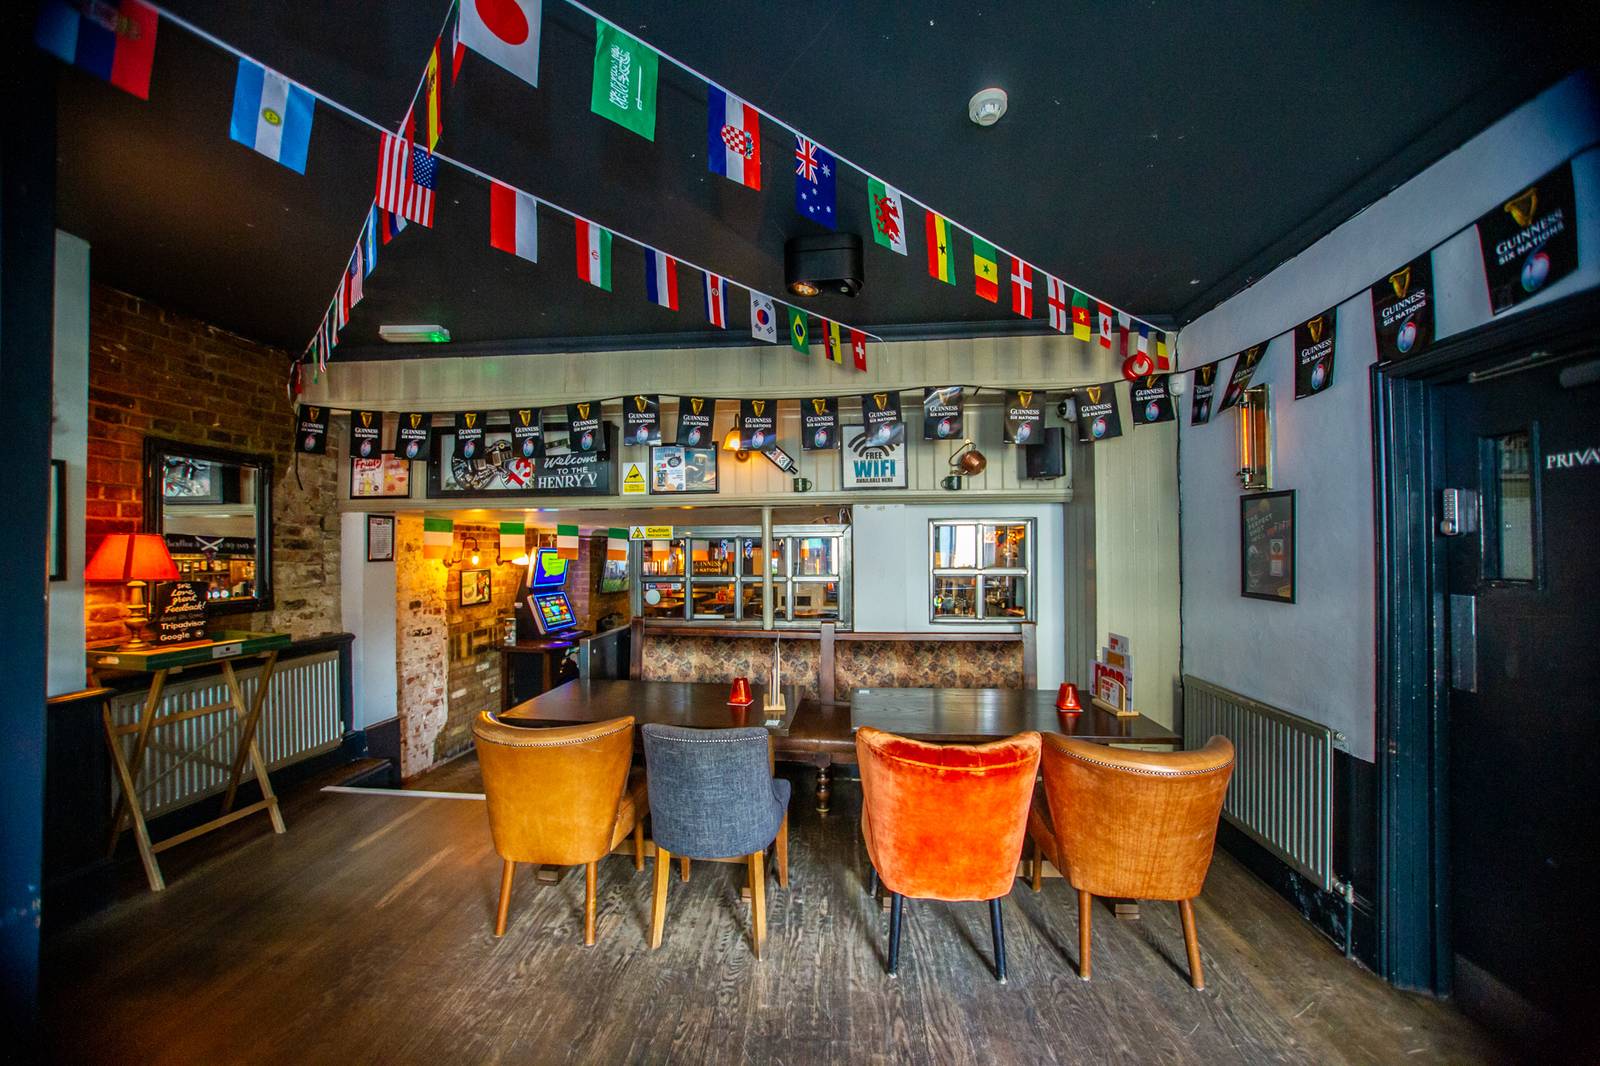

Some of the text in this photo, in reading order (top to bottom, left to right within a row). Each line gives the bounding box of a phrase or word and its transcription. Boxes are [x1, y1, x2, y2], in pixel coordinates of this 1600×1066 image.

[1496, 208, 1564, 256] GUINNESS
[1517, 222, 1564, 254] NATIONS
[1382, 289, 1426, 318] GUINNESS
[1395, 300, 1426, 321] NATIONS
[1302, 338, 1332, 358] GUINNESS
[1310, 348, 1332, 362] NATIONS
[1136, 388, 1164, 396] GUINNESS
[1081, 402, 1112, 412] GUINNESS
[1090, 409, 1112, 417] NATIONS
[683, 414, 710, 422] GUINNESS
[868, 410, 896, 418] GUINNESS
[572, 418, 598, 428] GUINNESS
[866, 451, 882, 460] FREE
[1546, 447, 1600, 470] PRIVA
[854, 459, 896, 478] WIFI
[538, 472, 598, 488] HENRY V
[161, 620, 206, 630] Tripadvisor
[160, 631, 190, 641] Google
